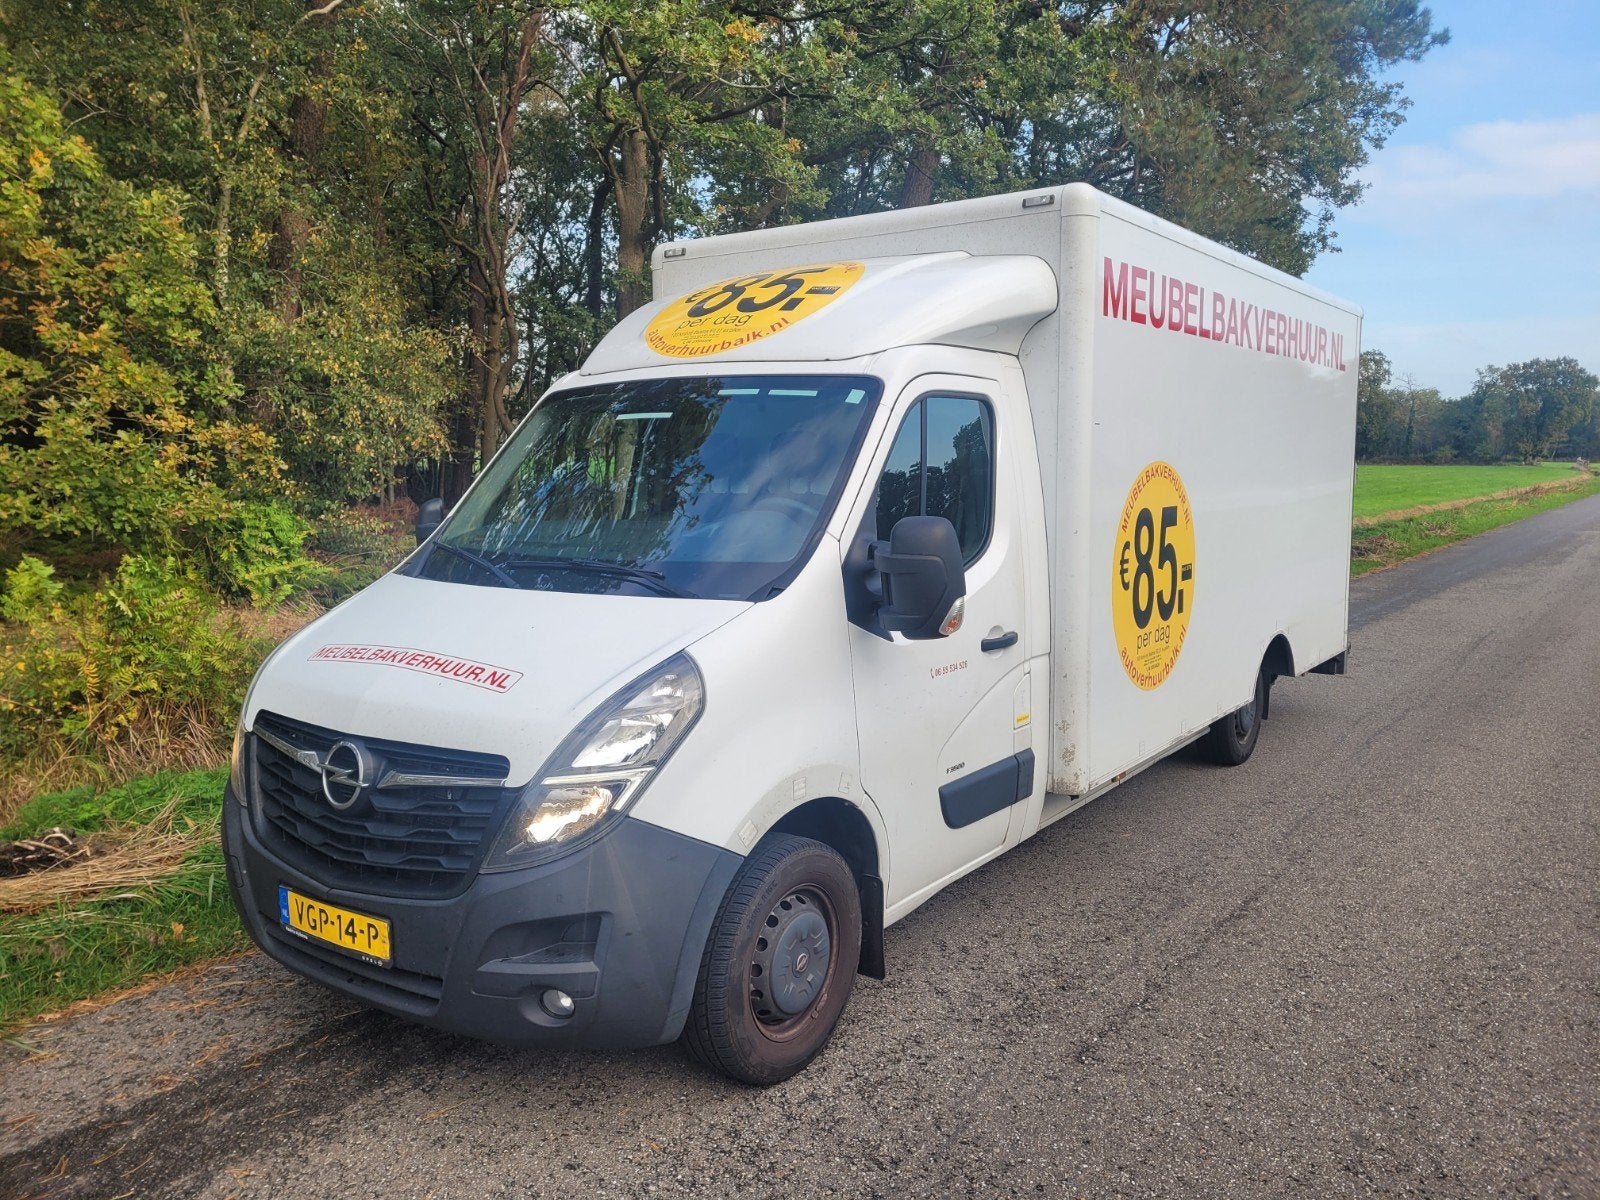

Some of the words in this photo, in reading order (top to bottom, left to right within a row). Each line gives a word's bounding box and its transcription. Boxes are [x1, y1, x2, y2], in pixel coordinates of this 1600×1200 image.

[675, 315, 708, 332] per
[713, 312, 752, 326] dag
[1103, 256, 1346, 372] MEUBELBAKVERHUUR.NL
[648, 317, 792, 356] autoverhuurbalk.nl
[1120, 624, 1187, 688] autoverhuurbalk.nl
[1136, 630, 1152, 655] per
[1154, 624, 1171, 644] dag
[315, 646, 511, 689] MEUBELBAKVERHUUR.NL
[295, 897, 379, 949] VGP-14-P
